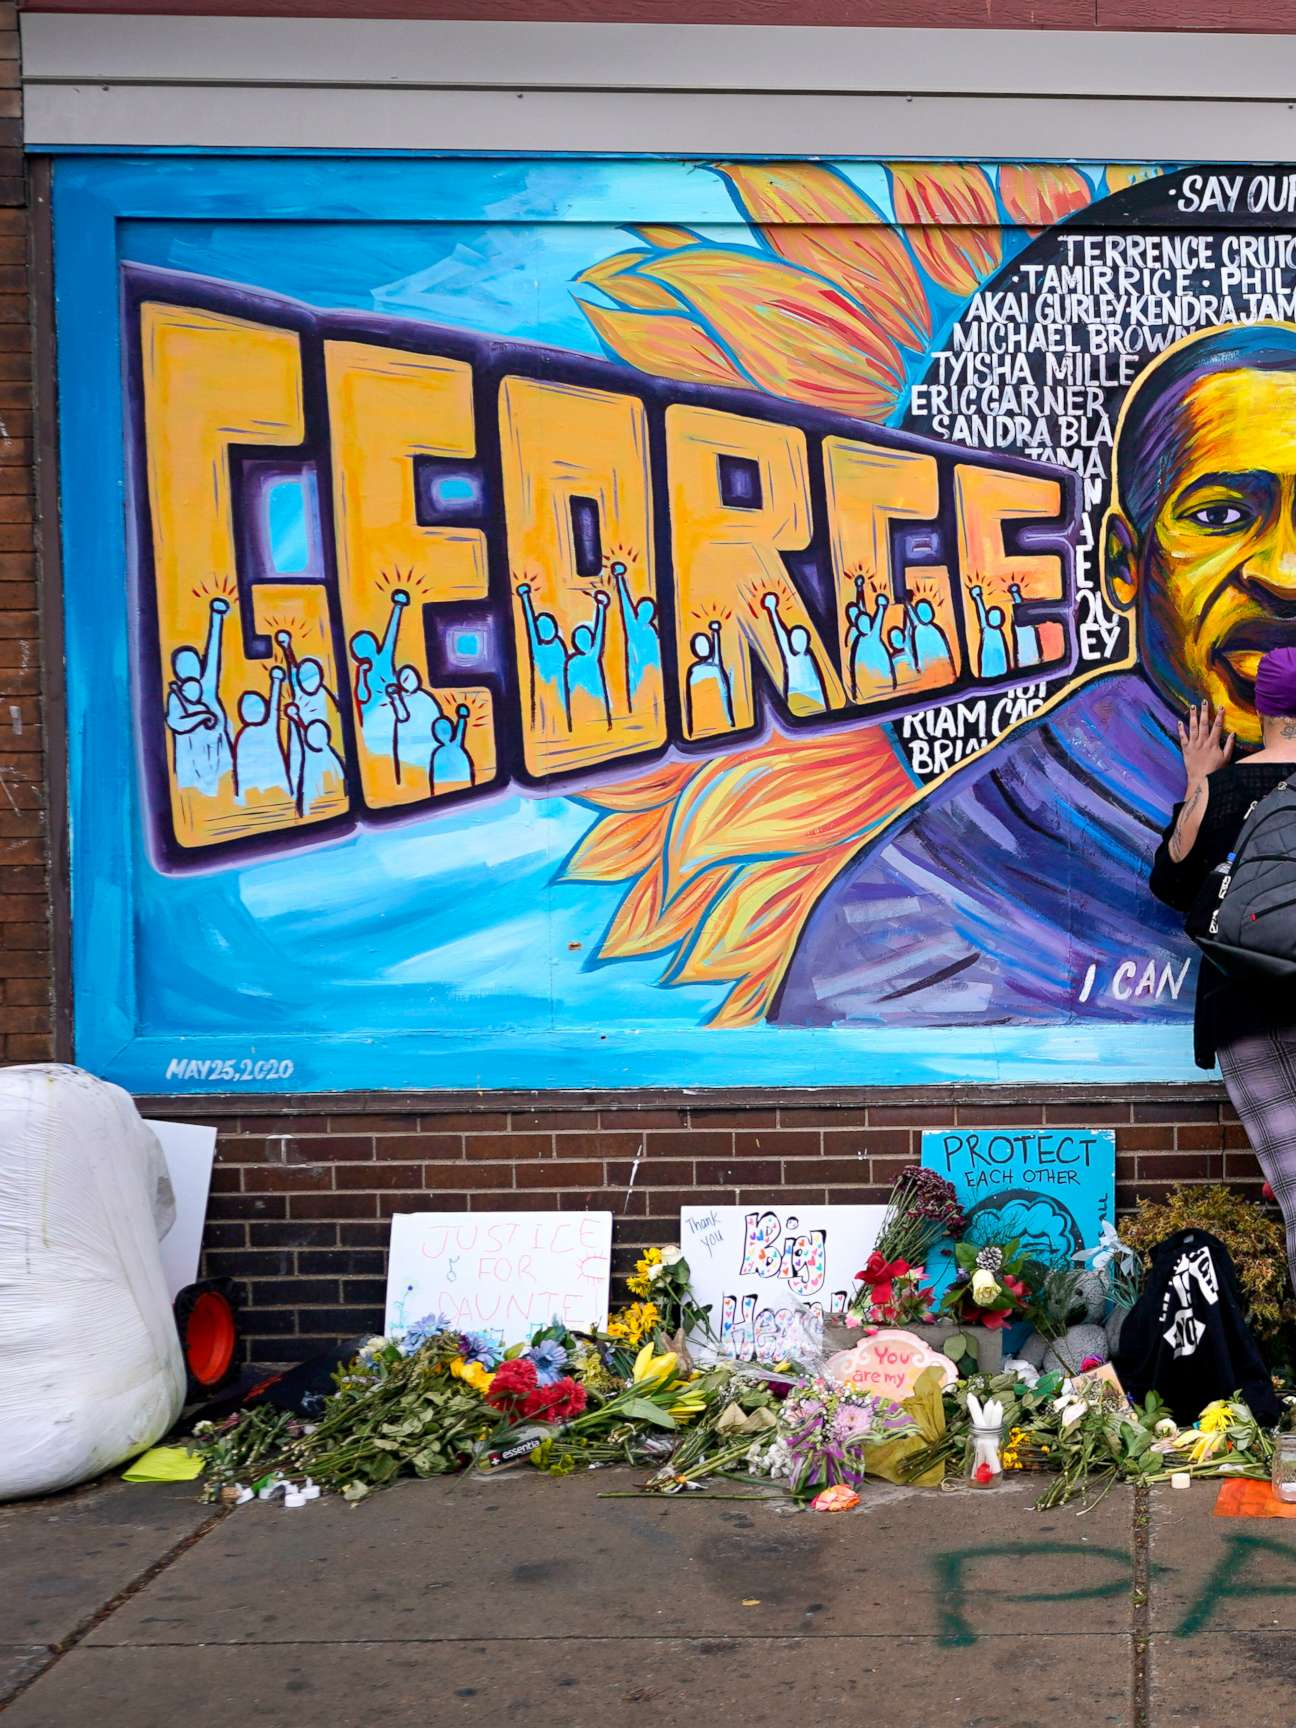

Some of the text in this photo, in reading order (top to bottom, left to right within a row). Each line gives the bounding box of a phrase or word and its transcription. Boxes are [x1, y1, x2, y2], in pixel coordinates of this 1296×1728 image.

[1178, 174, 1244, 213] SAY
[1057, 235, 1215, 269] TERRENCE
[1019, 265, 1115, 296] TAMIR
[1119, 267, 1194, 297] RICE
[965, 292, 1028, 323] AKAI
[1035, 294, 1127, 325] GURLEY
[1130, 295, 1240, 325] KENDRA
[953, 322, 1196, 354] MICHAEL BROWN
[931, 352, 1139, 387] TYISHA MILLE
[911, 385, 1106, 417] ERIC GARNER
[932, 415, 1053, 448] SANDRA
[139, 299, 1070, 848] GEORGE
[1079, 957, 1192, 1002] I CAN
[943, 1134, 1096, 1172] PROTECT
[964, 1168, 1080, 1187] EACH OTHER
[686, 1210, 721, 1235] Thank
[421, 1218, 602, 1260] JUSTICE
[700, 1228, 726, 1258] you
[477, 1254, 537, 1284] FOR
[874, 1346, 911, 1365] You
[852, 1369, 905, 1389] are my
